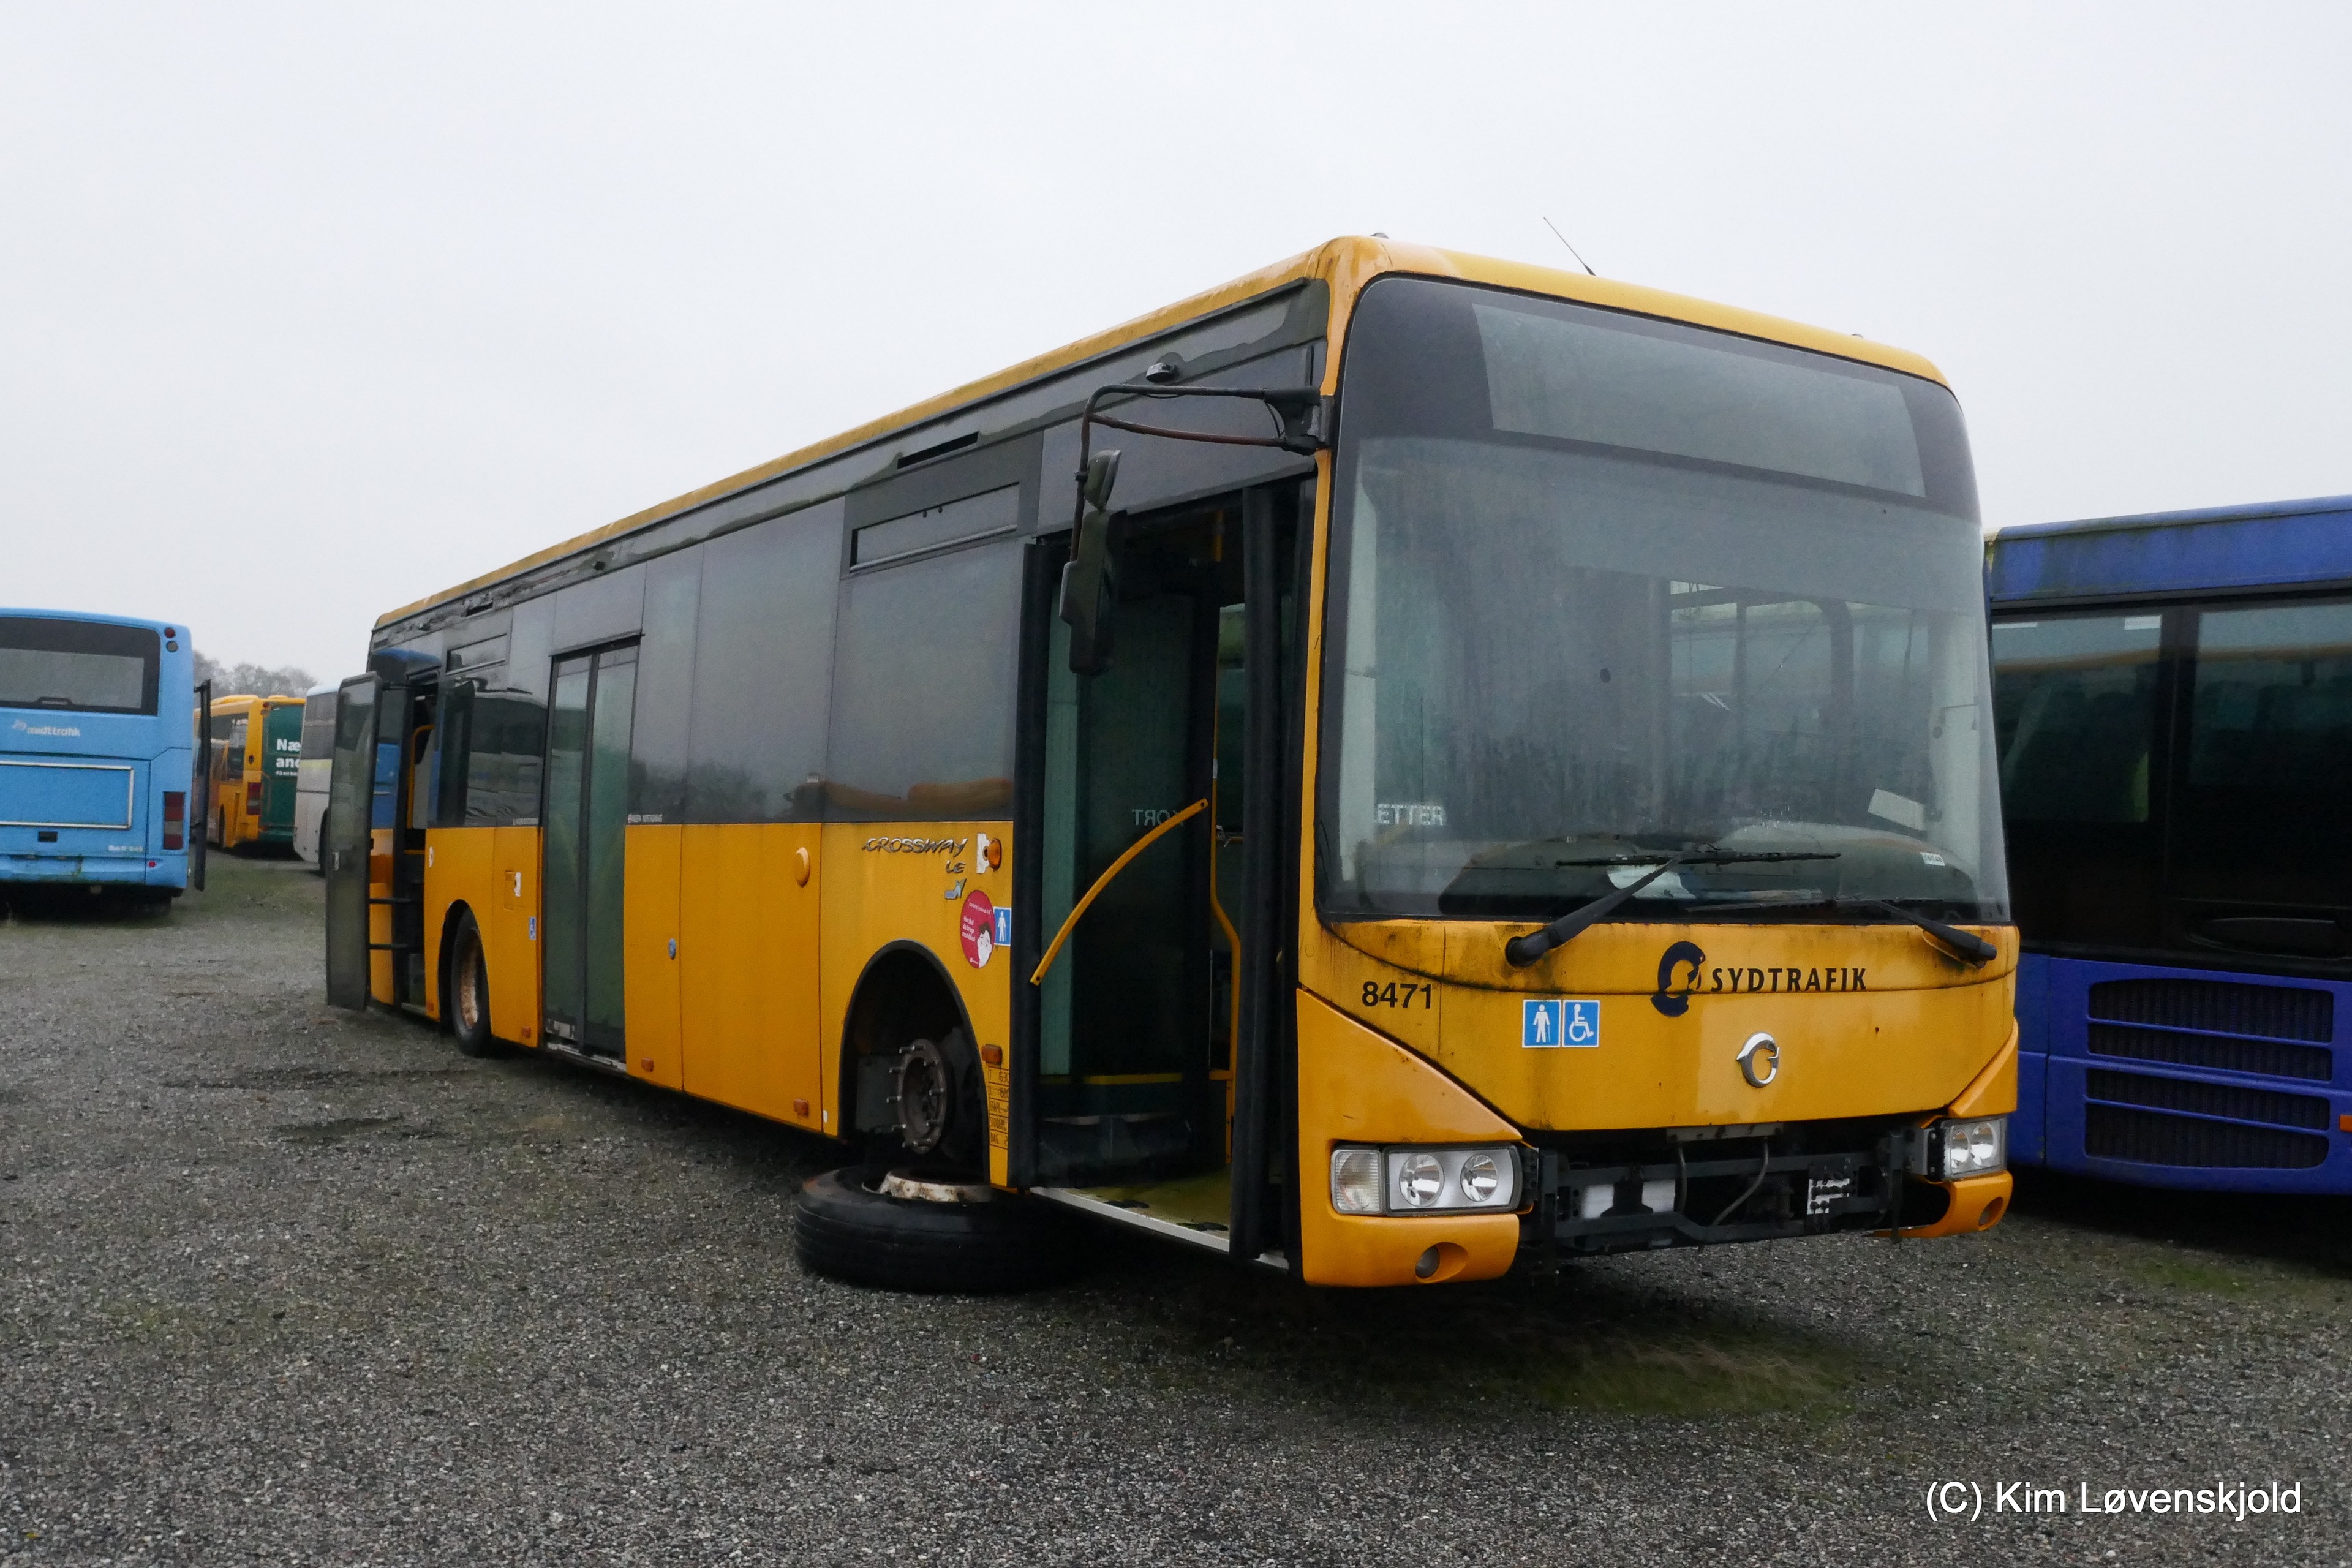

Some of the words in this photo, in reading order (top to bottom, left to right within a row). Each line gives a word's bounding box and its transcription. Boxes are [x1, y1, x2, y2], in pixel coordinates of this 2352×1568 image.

[862, 837, 968, 858] CROSSWAY
[945, 860, 966, 873] LE
[1711, 968, 1866, 992] SYDTRAFIK
[1362, 981, 1431, 1009] 8471
